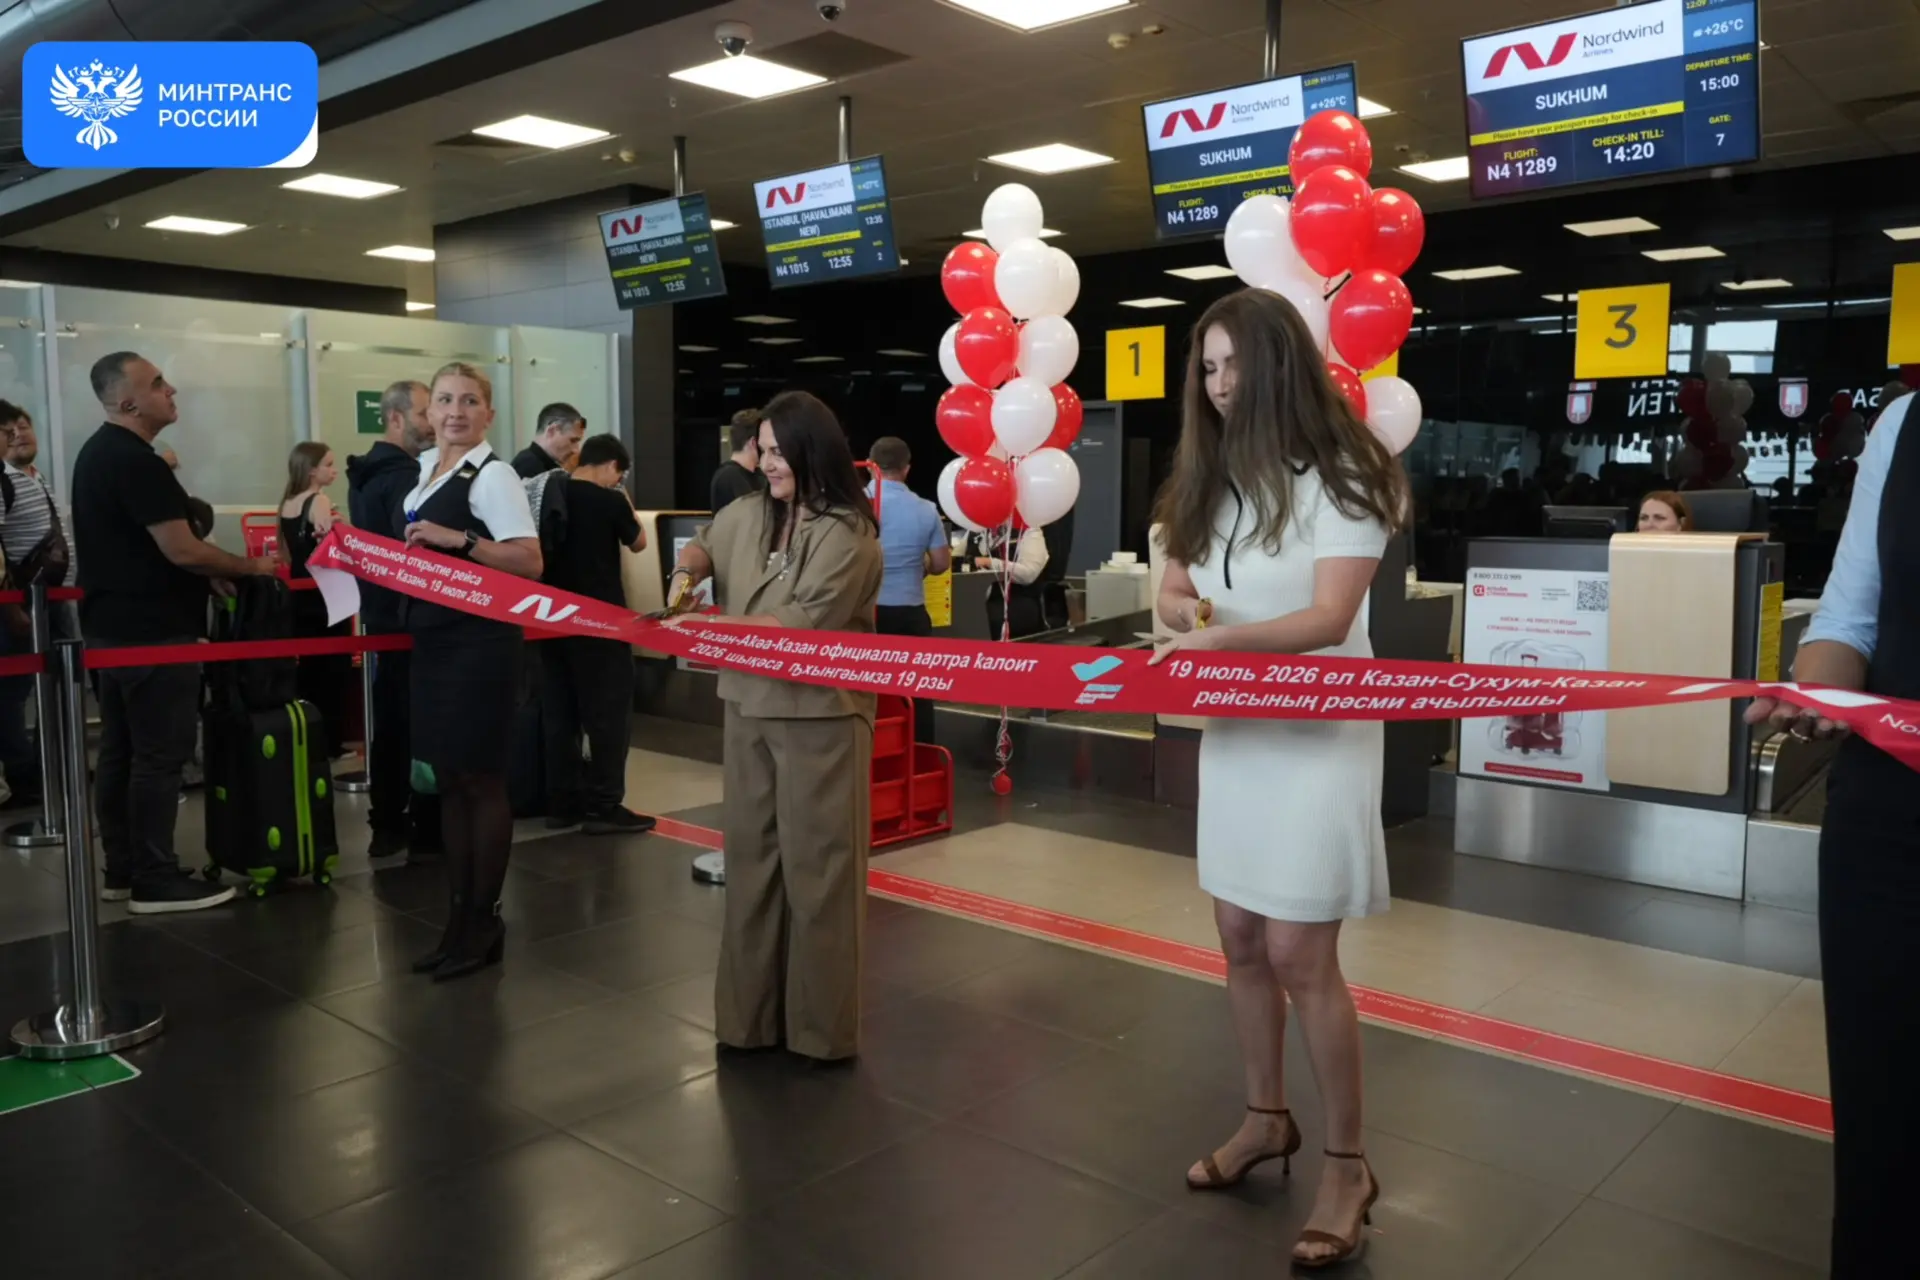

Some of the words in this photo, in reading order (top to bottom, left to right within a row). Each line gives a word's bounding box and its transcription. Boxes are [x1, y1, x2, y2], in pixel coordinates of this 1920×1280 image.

[1582, 21, 1664, 48] Nordwind
[1704, 18, 1744, 36] +26°C
[1685, 56, 1730, 72] DEPARTURE
[1700, 74, 1739, 92] 15:00
[1231, 96, 1290, 116] Nordwind
[1535, 84, 1608, 110] SUKHUM
[1493, 130, 1516, 141] Please
[1518, 127, 1535, 136] have
[1536, 125, 1553, 135] your
[1554, 119, 1587, 132] passport
[1588, 116, 1609, 127] ready
[1610, 114, 1622, 122] for
[1624, 108, 1658, 120] check-in
[1709, 114, 1732, 124] GATE:
[1592, 133, 1638, 147] CHECK-IN
[1640, 129, 1665, 140] TILL:
[1716, 133, 1725, 146] 7
[1199, 146, 1252, 166] SUKHUM
[1504, 148, 1539, 160] FLIGHT:
[1603, 142, 1655, 164] 14:20
[1487, 164, 1511, 181] N4
[1515, 156, 1557, 177] 1289
[1178, 198, 1204, 208] FLIGHT:
[764, 215, 801, 231] ISTANBUL
[801, 204, 853, 225] (HAVALIMANI
[1167, 210, 1185, 225] N4
[1188, 205, 1219, 222] 1289
[799, 224, 821, 238] NEW)
[776, 265, 789, 277] N4
[789, 262, 810, 275] 1015
[828, 256, 853, 269] 12:55
[665, 280, 686, 292] 12:55
[1605, 304, 1637, 349] 3
[1128, 341, 1140, 376] 1
[343, 534, 407, 564] Официальное
[407, 557, 451, 578] открытие
[451, 569, 483, 587] рейса
[360, 557, 389, 578] Сухум
[396, 569, 428, 589] Казань
[430, 579, 441, 592] 19
[440, 585, 468, 600] июля
[466, 590, 493, 607] 2026
[689, 642, 726, 659] 2026
[896, 670, 916, 688] 19
[915, 676, 954, 692] рзы
[820, 643, 908, 665] официалла
[912, 651, 970, 671] аартра
[1168, 660, 1193, 678] 19
[1196, 665, 1256, 682] июль
[1261, 665, 1320, 684] 2026
[1323, 671, 1354, 686] ел
[1359, 669, 1648, 692] Казан-Сухум-Казан
[1192, 687, 1317, 711] рейсының
[1320, 695, 1406, 713] рәсми
[1410, 695, 1568, 710] ачылышы
[1879, 712, 1920, 736] No
